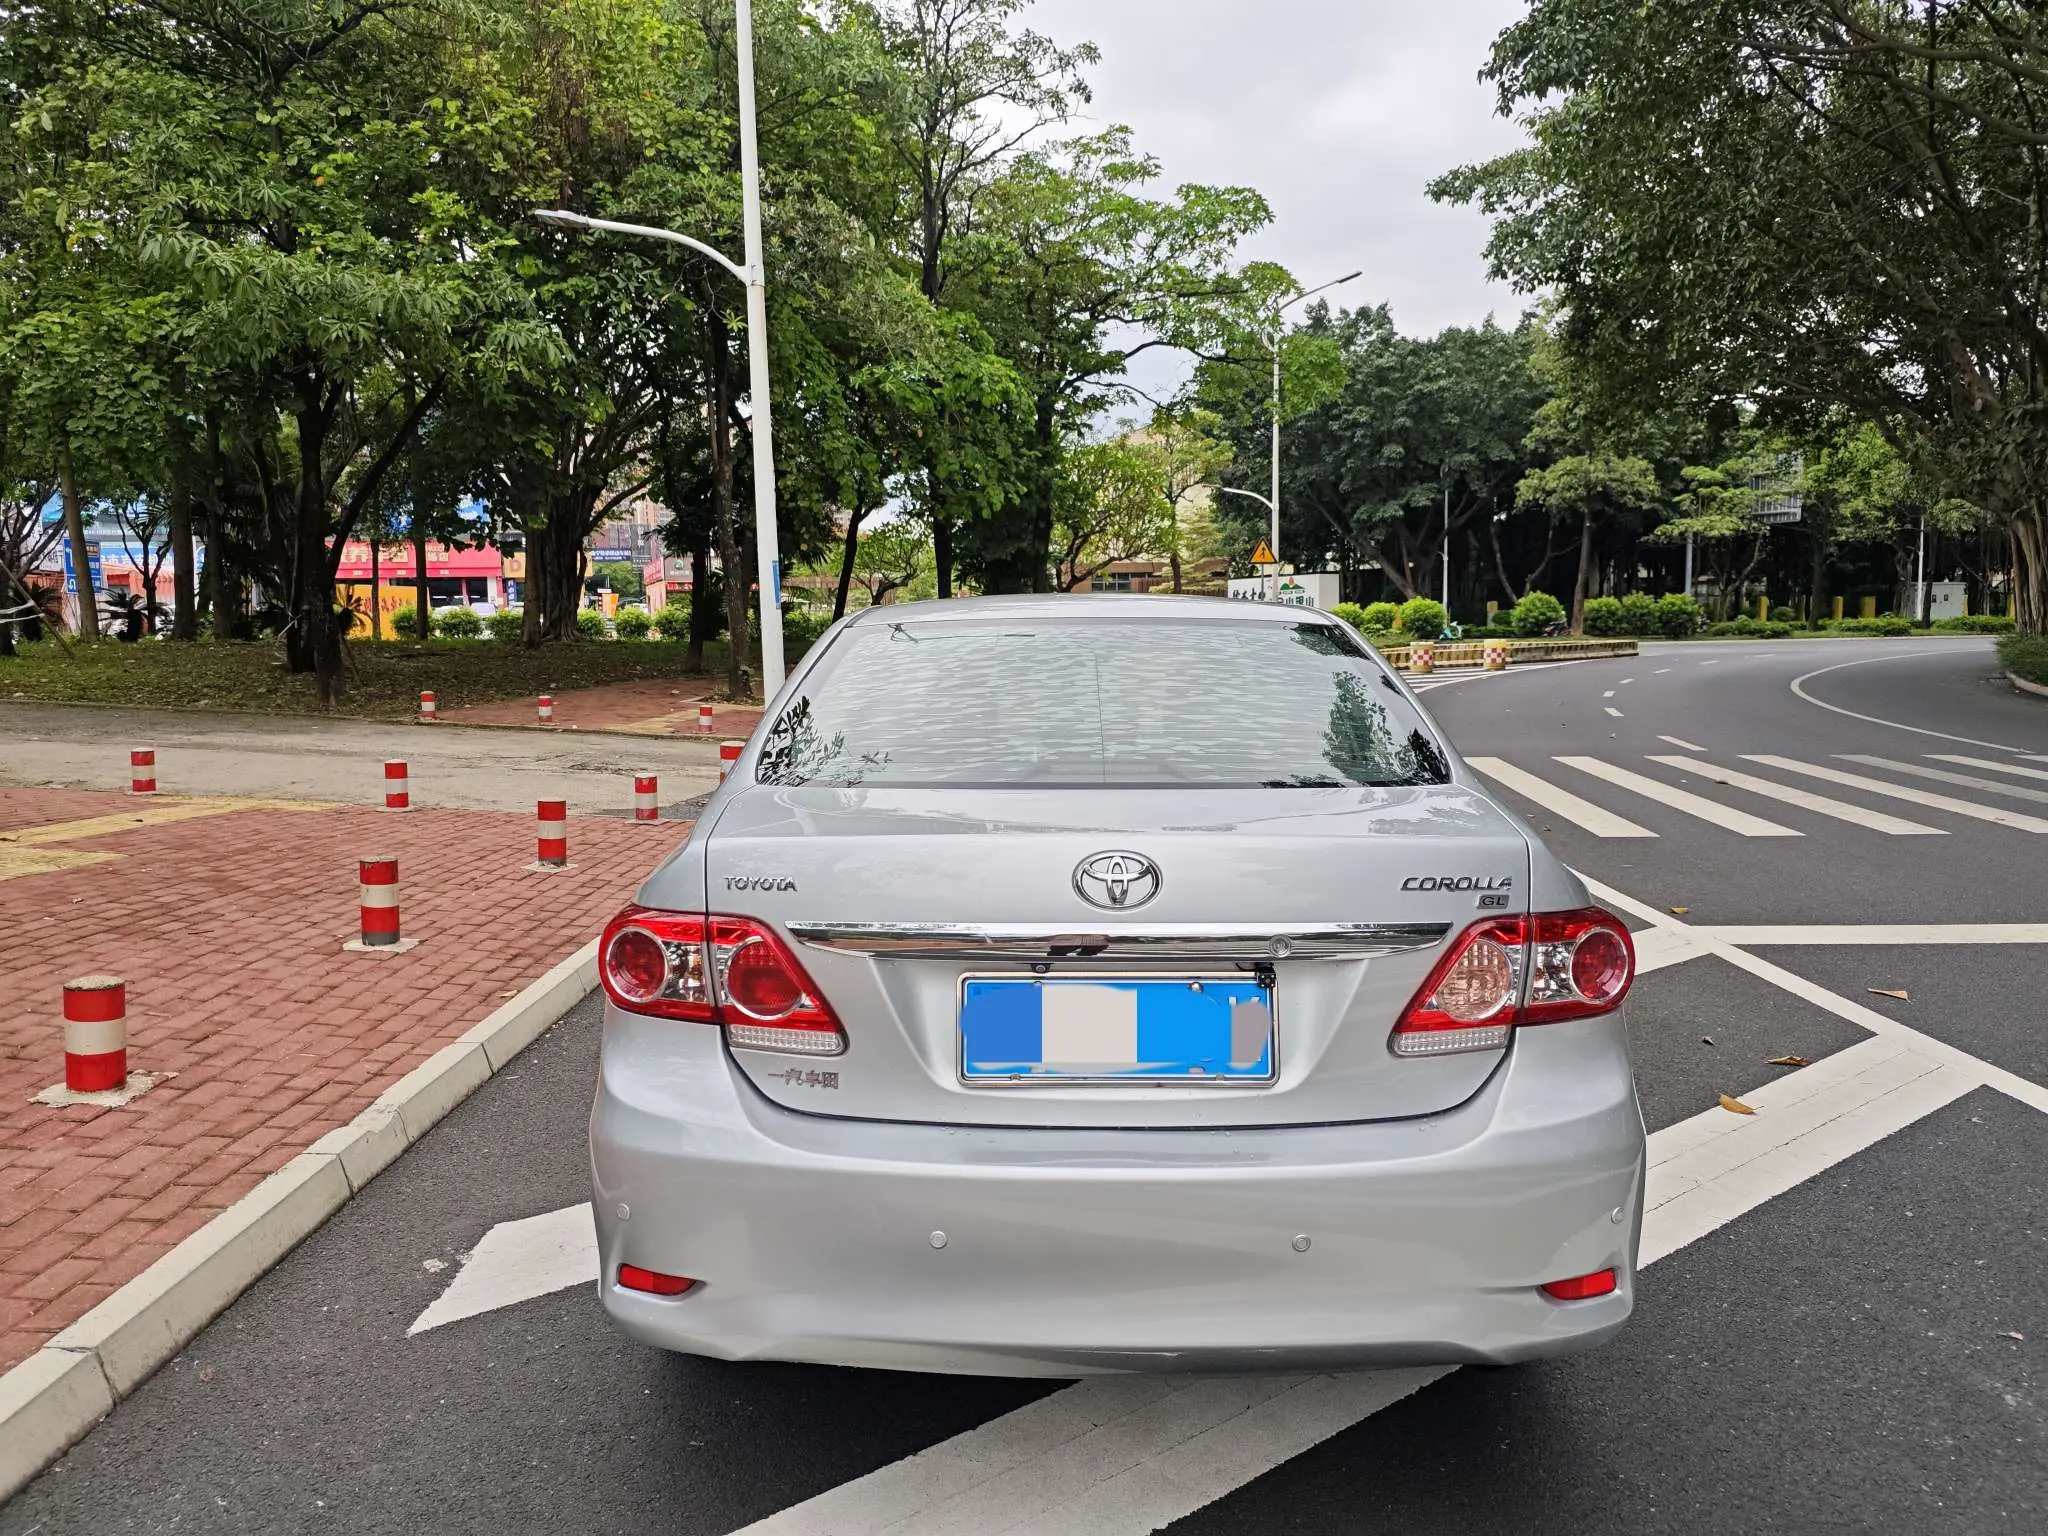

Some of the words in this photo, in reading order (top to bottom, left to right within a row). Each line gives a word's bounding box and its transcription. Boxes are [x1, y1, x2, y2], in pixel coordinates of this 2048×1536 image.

[724, 876, 797, 892] TOYOTA
[1400, 876, 1512, 892] COROLLA
[1481, 896, 1505, 906] GL
